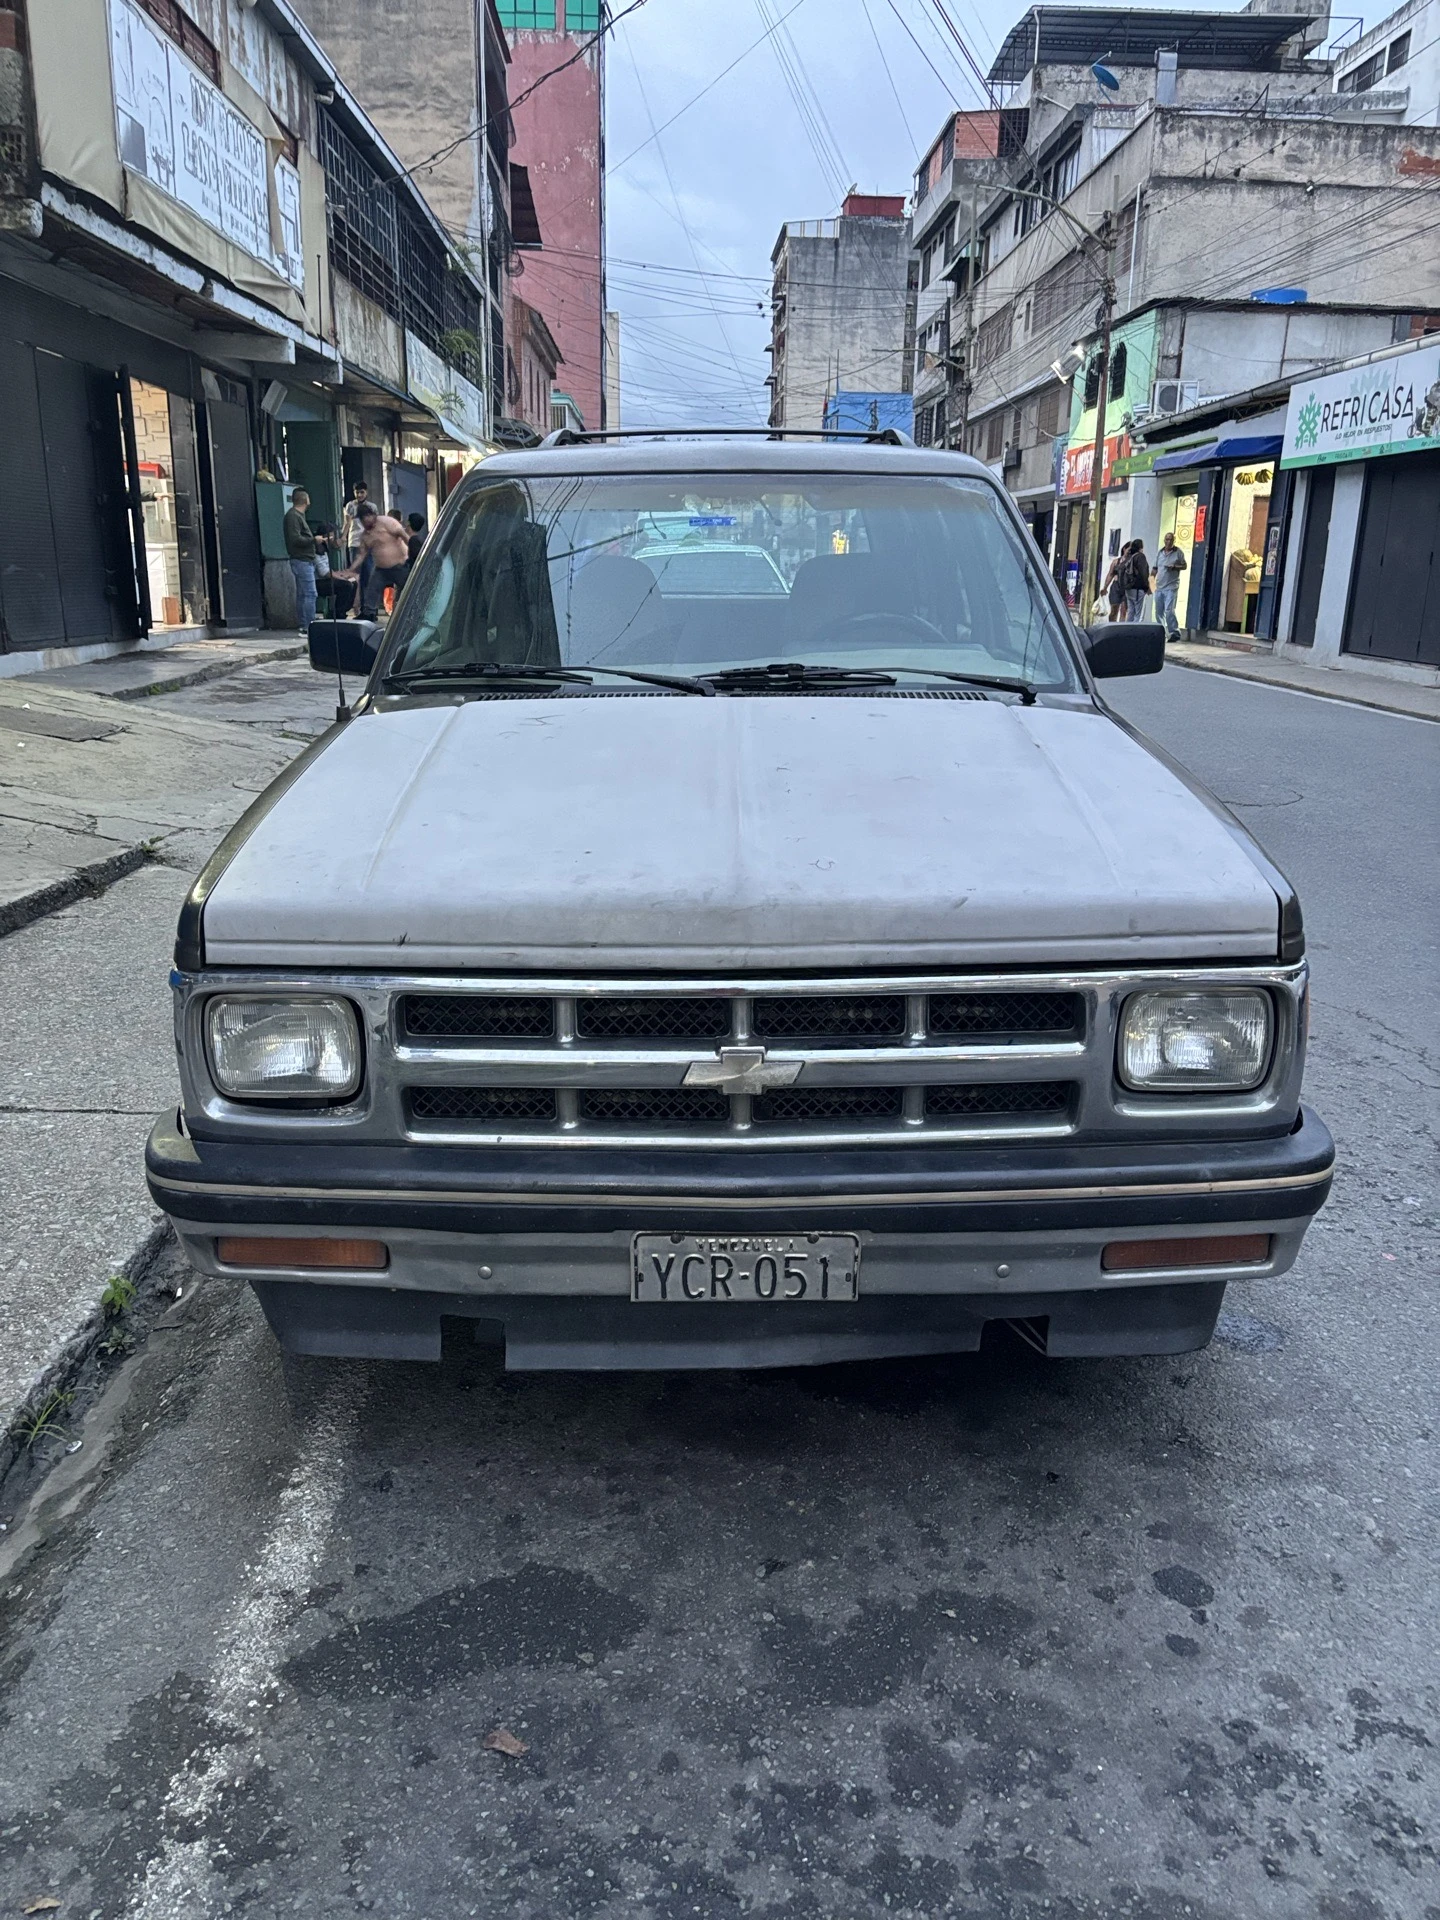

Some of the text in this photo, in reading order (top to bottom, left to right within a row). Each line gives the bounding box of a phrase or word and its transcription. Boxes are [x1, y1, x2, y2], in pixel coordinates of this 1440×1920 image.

[1343, 430, 1356, 438] MEJOR
[695, 1238, 795, 1252] VENEZUELA
[651, 1253, 831, 1300] YCR-051
